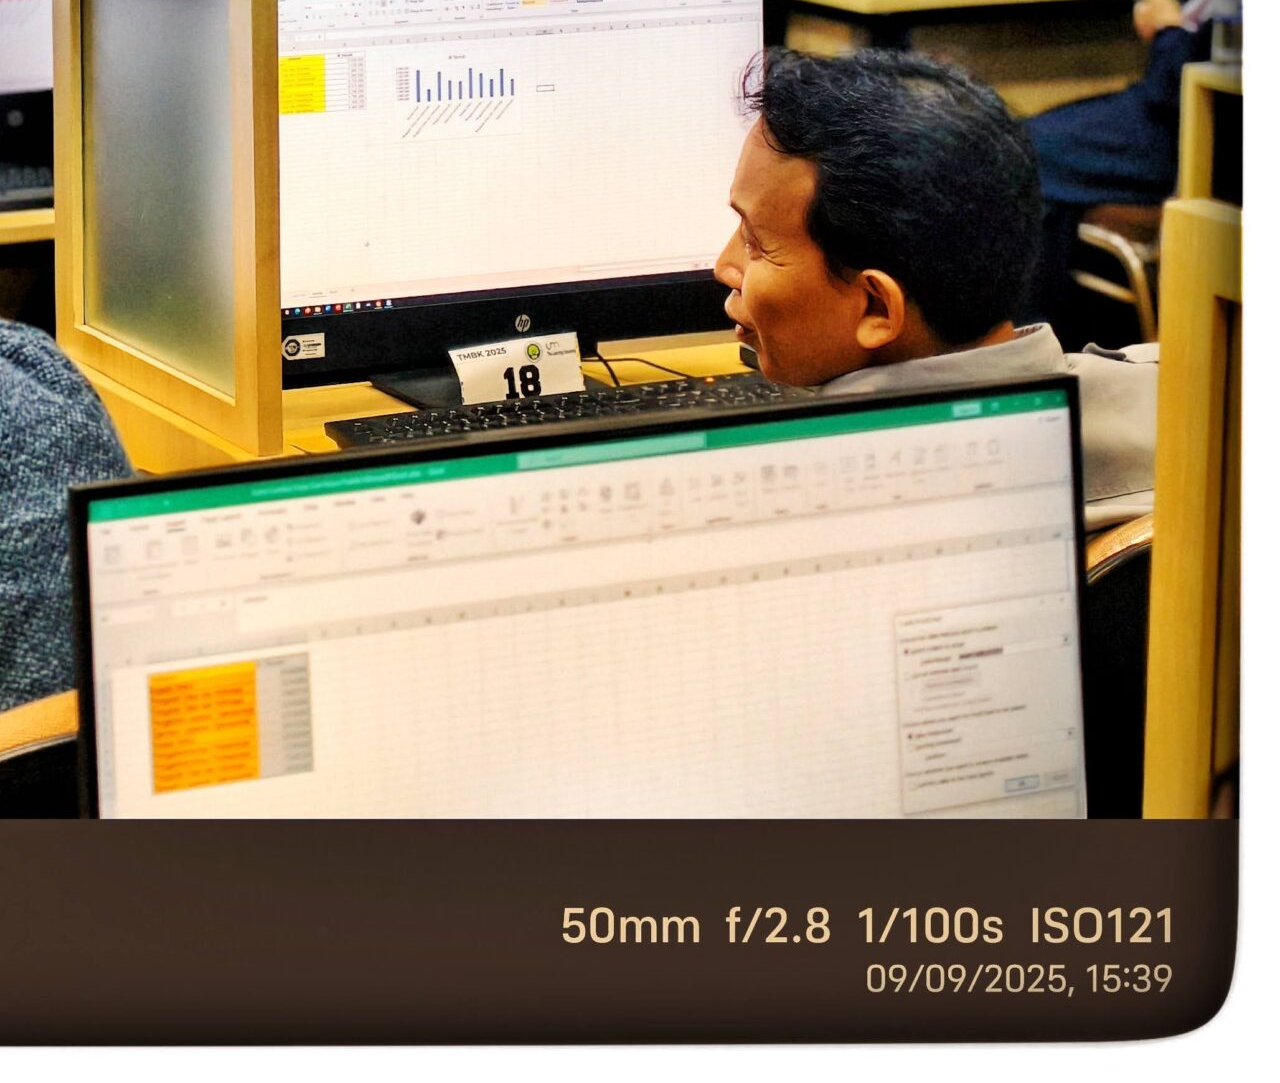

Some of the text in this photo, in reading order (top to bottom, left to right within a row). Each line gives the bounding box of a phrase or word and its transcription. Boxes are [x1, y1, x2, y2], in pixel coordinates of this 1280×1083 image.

[516, 314, 530, 332] hp
[457, 347, 507, 362] TMBK 2025
[503, 364, 542, 400] 18
